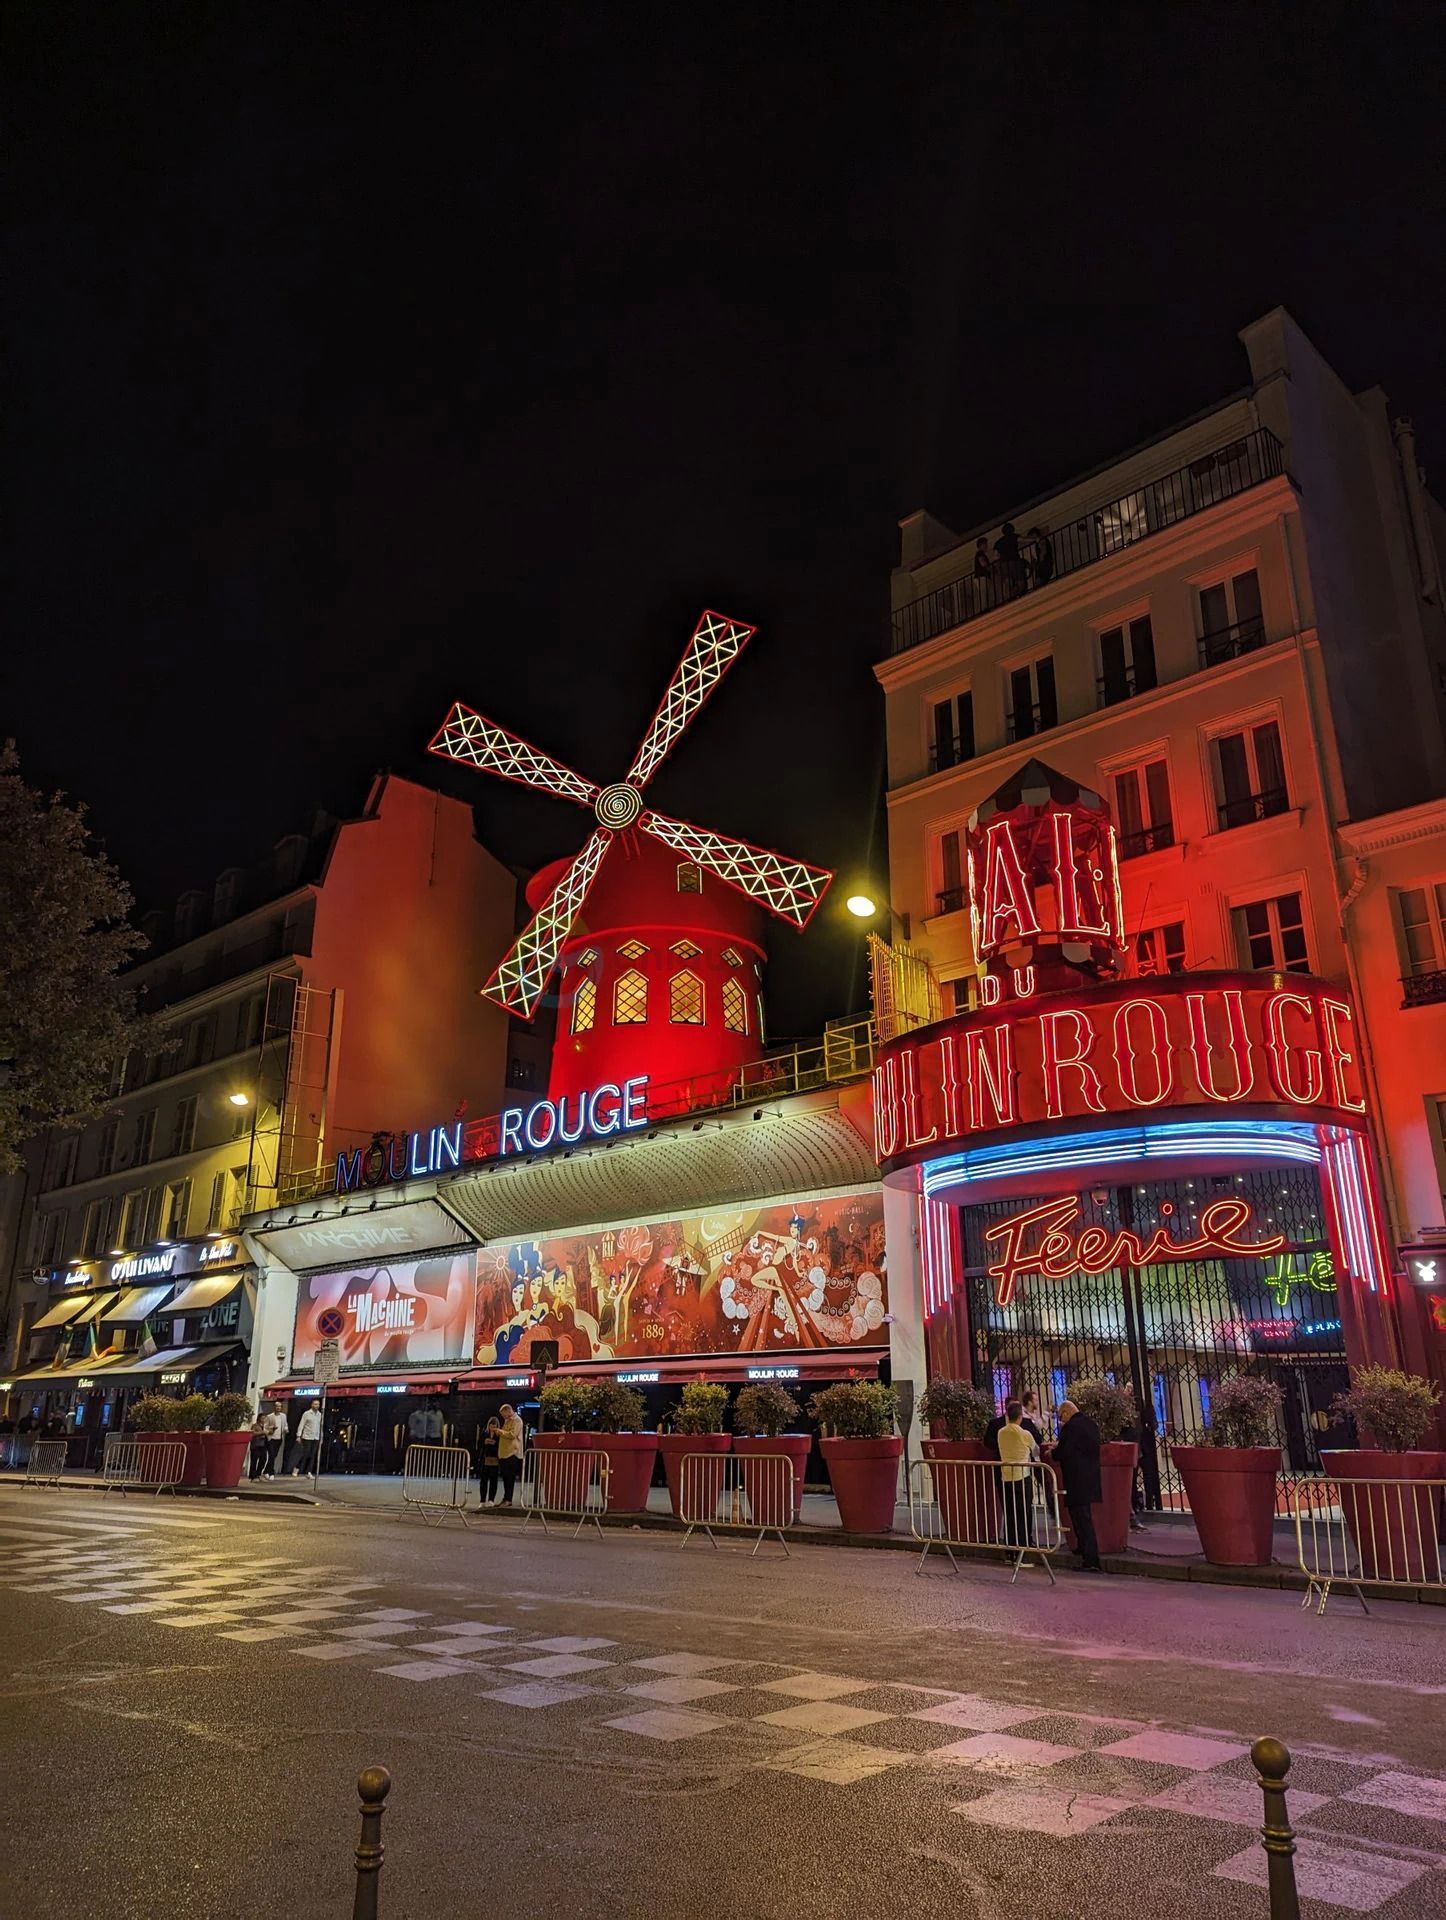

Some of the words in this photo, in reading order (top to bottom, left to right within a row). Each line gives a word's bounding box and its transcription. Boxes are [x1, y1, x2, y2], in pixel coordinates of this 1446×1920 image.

[967, 814, 1112, 966] AL
[980, 966, 1035, 1006] DU
[872, 1024, 1017, 1165] ULIN
[1039, 990, 1366, 1119] ROUGE
[335, 1122, 463, 1194] MOULIN
[501, 1075, 649, 1155] ROUGE
[985, 1196, 1284, 1306] Féerie
[642, 1323, 665, 1342] 1889
[639, 1373, 659, 1382] ROUGE
[748, 1370, 775, 1379] MOULIN
[776, 1369, 799, 1378] ROUGE
